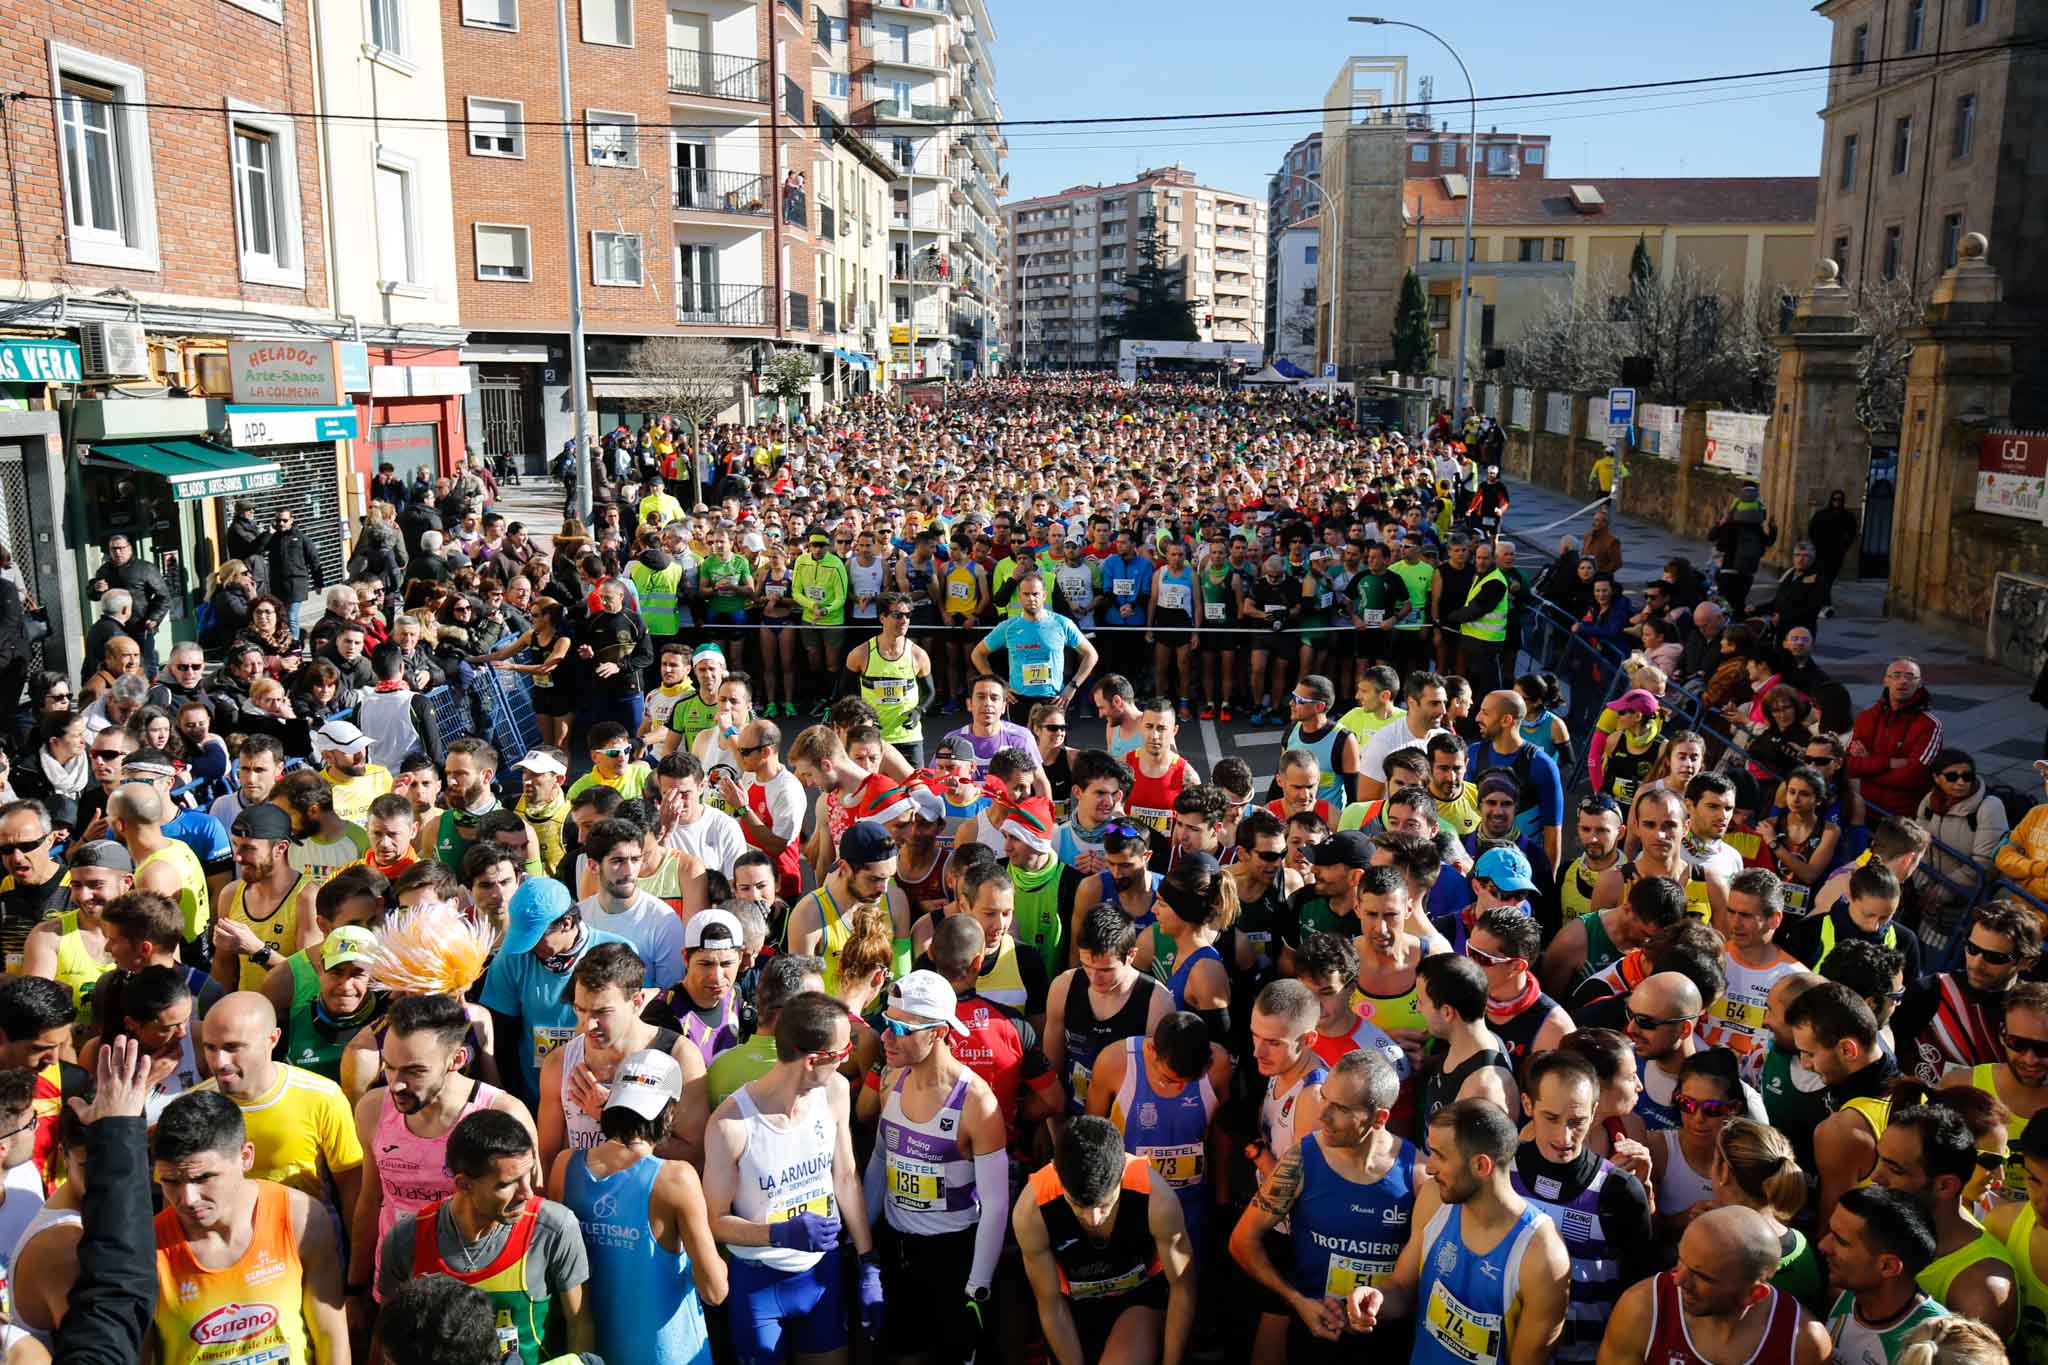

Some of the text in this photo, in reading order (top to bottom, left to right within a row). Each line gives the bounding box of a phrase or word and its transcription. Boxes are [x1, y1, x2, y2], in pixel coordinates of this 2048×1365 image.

[22, 347, 80, 380] VERA
[249, 347, 317, 367] HELADOS
[245, 369, 324, 382] Arte-Sanos
[250, 386, 320, 398] LA COLMENA
[178, 481, 206, 497] HELADOS
[1031, 669, 1040, 679] 77
[1727, 992, 1767, 1008] SETEL
[1726, 1001, 1745, 1020] 64
[960, 1046, 993, 1061] tapia
[908, 1136, 931, 1151] Racing
[1154, 1146, 1198, 1157] SETEL
[760, 1151, 833, 1190] LA ARMUÑA
[896, 1160, 937, 1175] SETEL
[1156, 1159, 1177, 1175] 73
[896, 1171, 920, 1194] 136
[785, 1187, 827, 1207] SETEL
[1563, 1211, 1592, 1225] RACING
[1446, 1296, 1493, 1328] SETEL
[200, 1311, 273, 1342] Serrano
[1445, 1308, 1465, 1339] 74
[263, 1334, 286, 1346] Hoy
